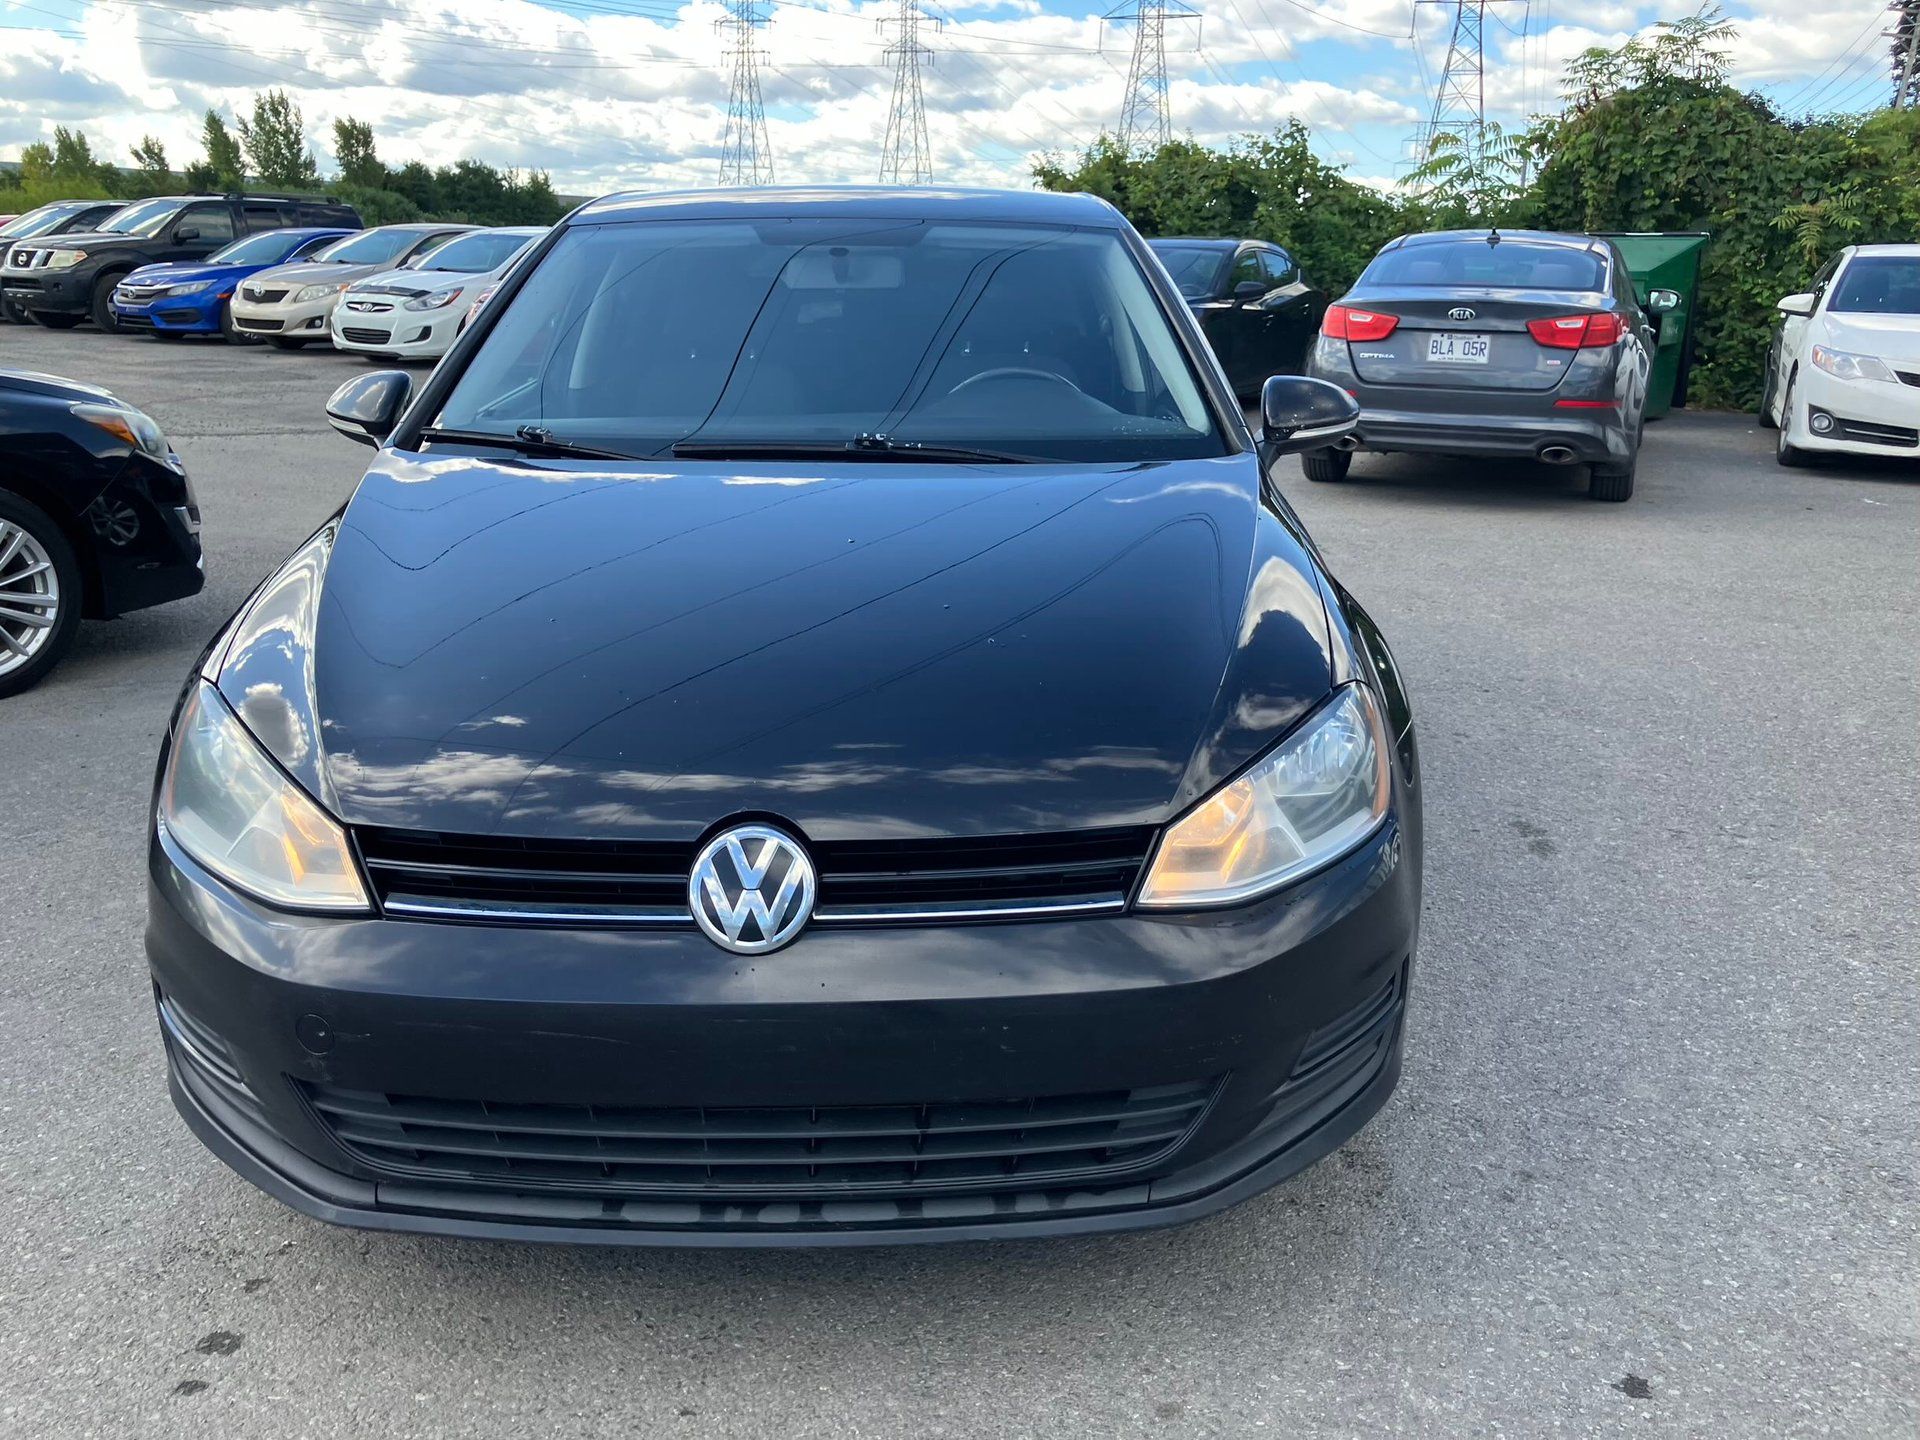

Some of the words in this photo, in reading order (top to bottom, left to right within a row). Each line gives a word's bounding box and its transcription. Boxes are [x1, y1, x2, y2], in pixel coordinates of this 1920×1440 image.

[1451, 309, 1472, 320] KIA
[1431, 340, 1454, 355] BLA
[696, 831, 809, 948] VW
